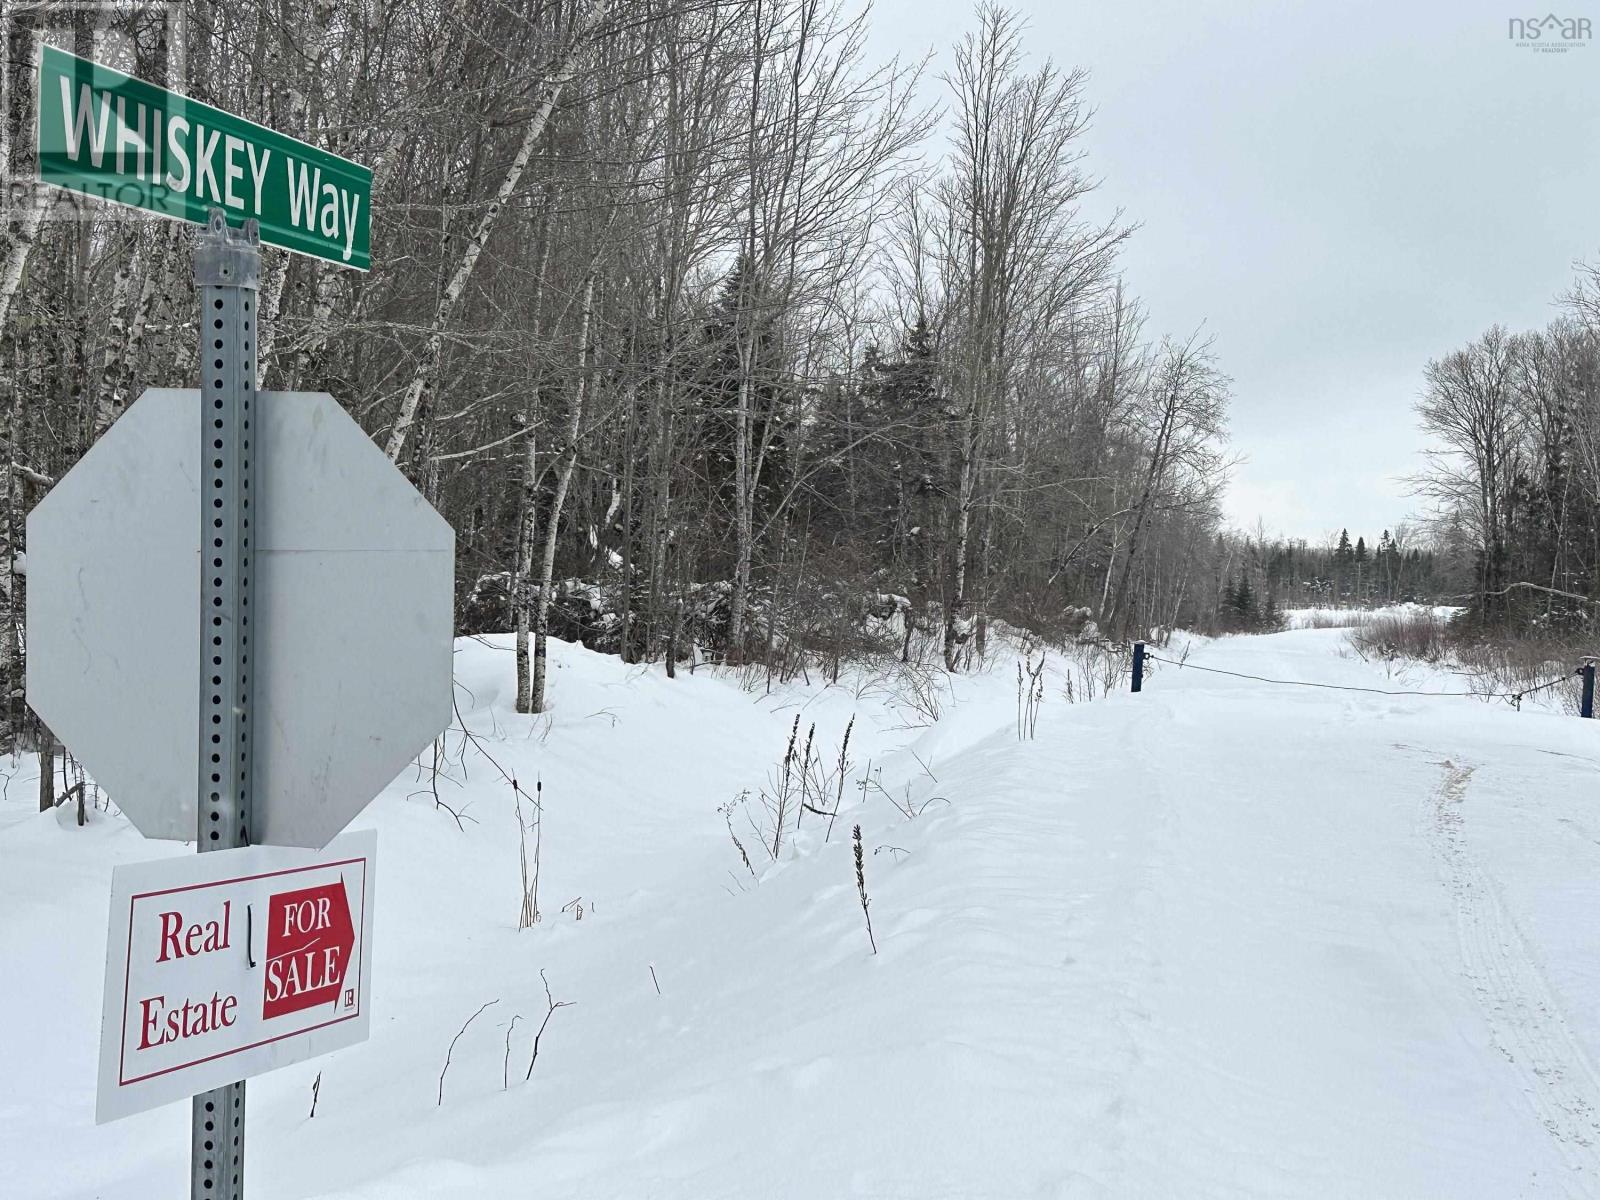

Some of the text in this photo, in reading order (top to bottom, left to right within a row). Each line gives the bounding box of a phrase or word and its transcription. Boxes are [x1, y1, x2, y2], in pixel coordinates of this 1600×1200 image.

[59, 75, 360, 261] WHISKEY Way
[155, 900, 231, 963] Real
[281, 897, 331, 938] FOR
[265, 945, 341, 1002] SALE
[136, 991, 238, 1051] Estate
